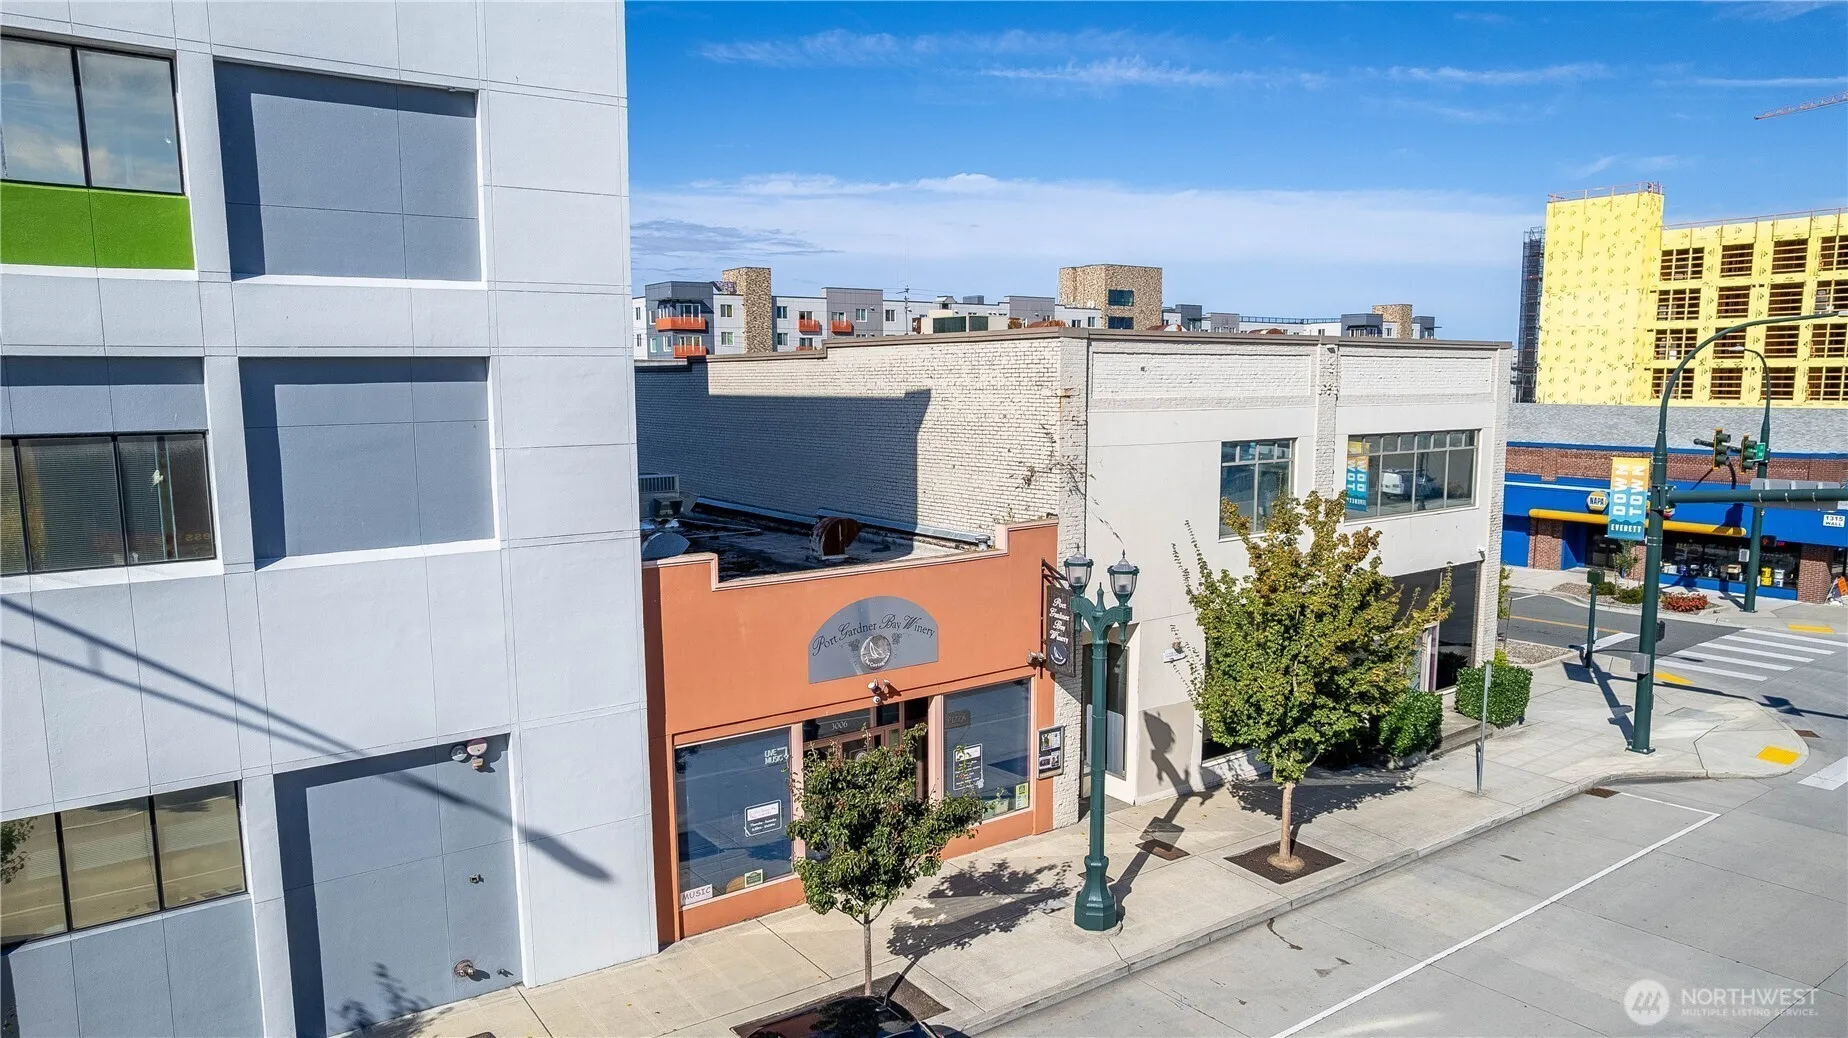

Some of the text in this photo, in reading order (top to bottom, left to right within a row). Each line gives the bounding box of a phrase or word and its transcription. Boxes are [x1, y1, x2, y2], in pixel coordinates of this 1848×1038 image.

[1612, 464, 1629, 515] DOWN
[1629, 465, 1646, 516] TOWN
[1589, 497, 1605, 506] NAPA
[1610, 523, 1642, 533] EVERETT
[1052, 597, 1067, 609] Port
[1052, 620, 1066, 632] Bay
[812, 613, 936, 656] Port Gardner Bay Winery
[1049, 629, 1069, 644] Winery
[831, 721, 848, 731] 3006
[764, 749, 777, 757] LIVE
[764, 755, 784, 765] MUSIC
[681, 886, 712, 901] MUSIC
